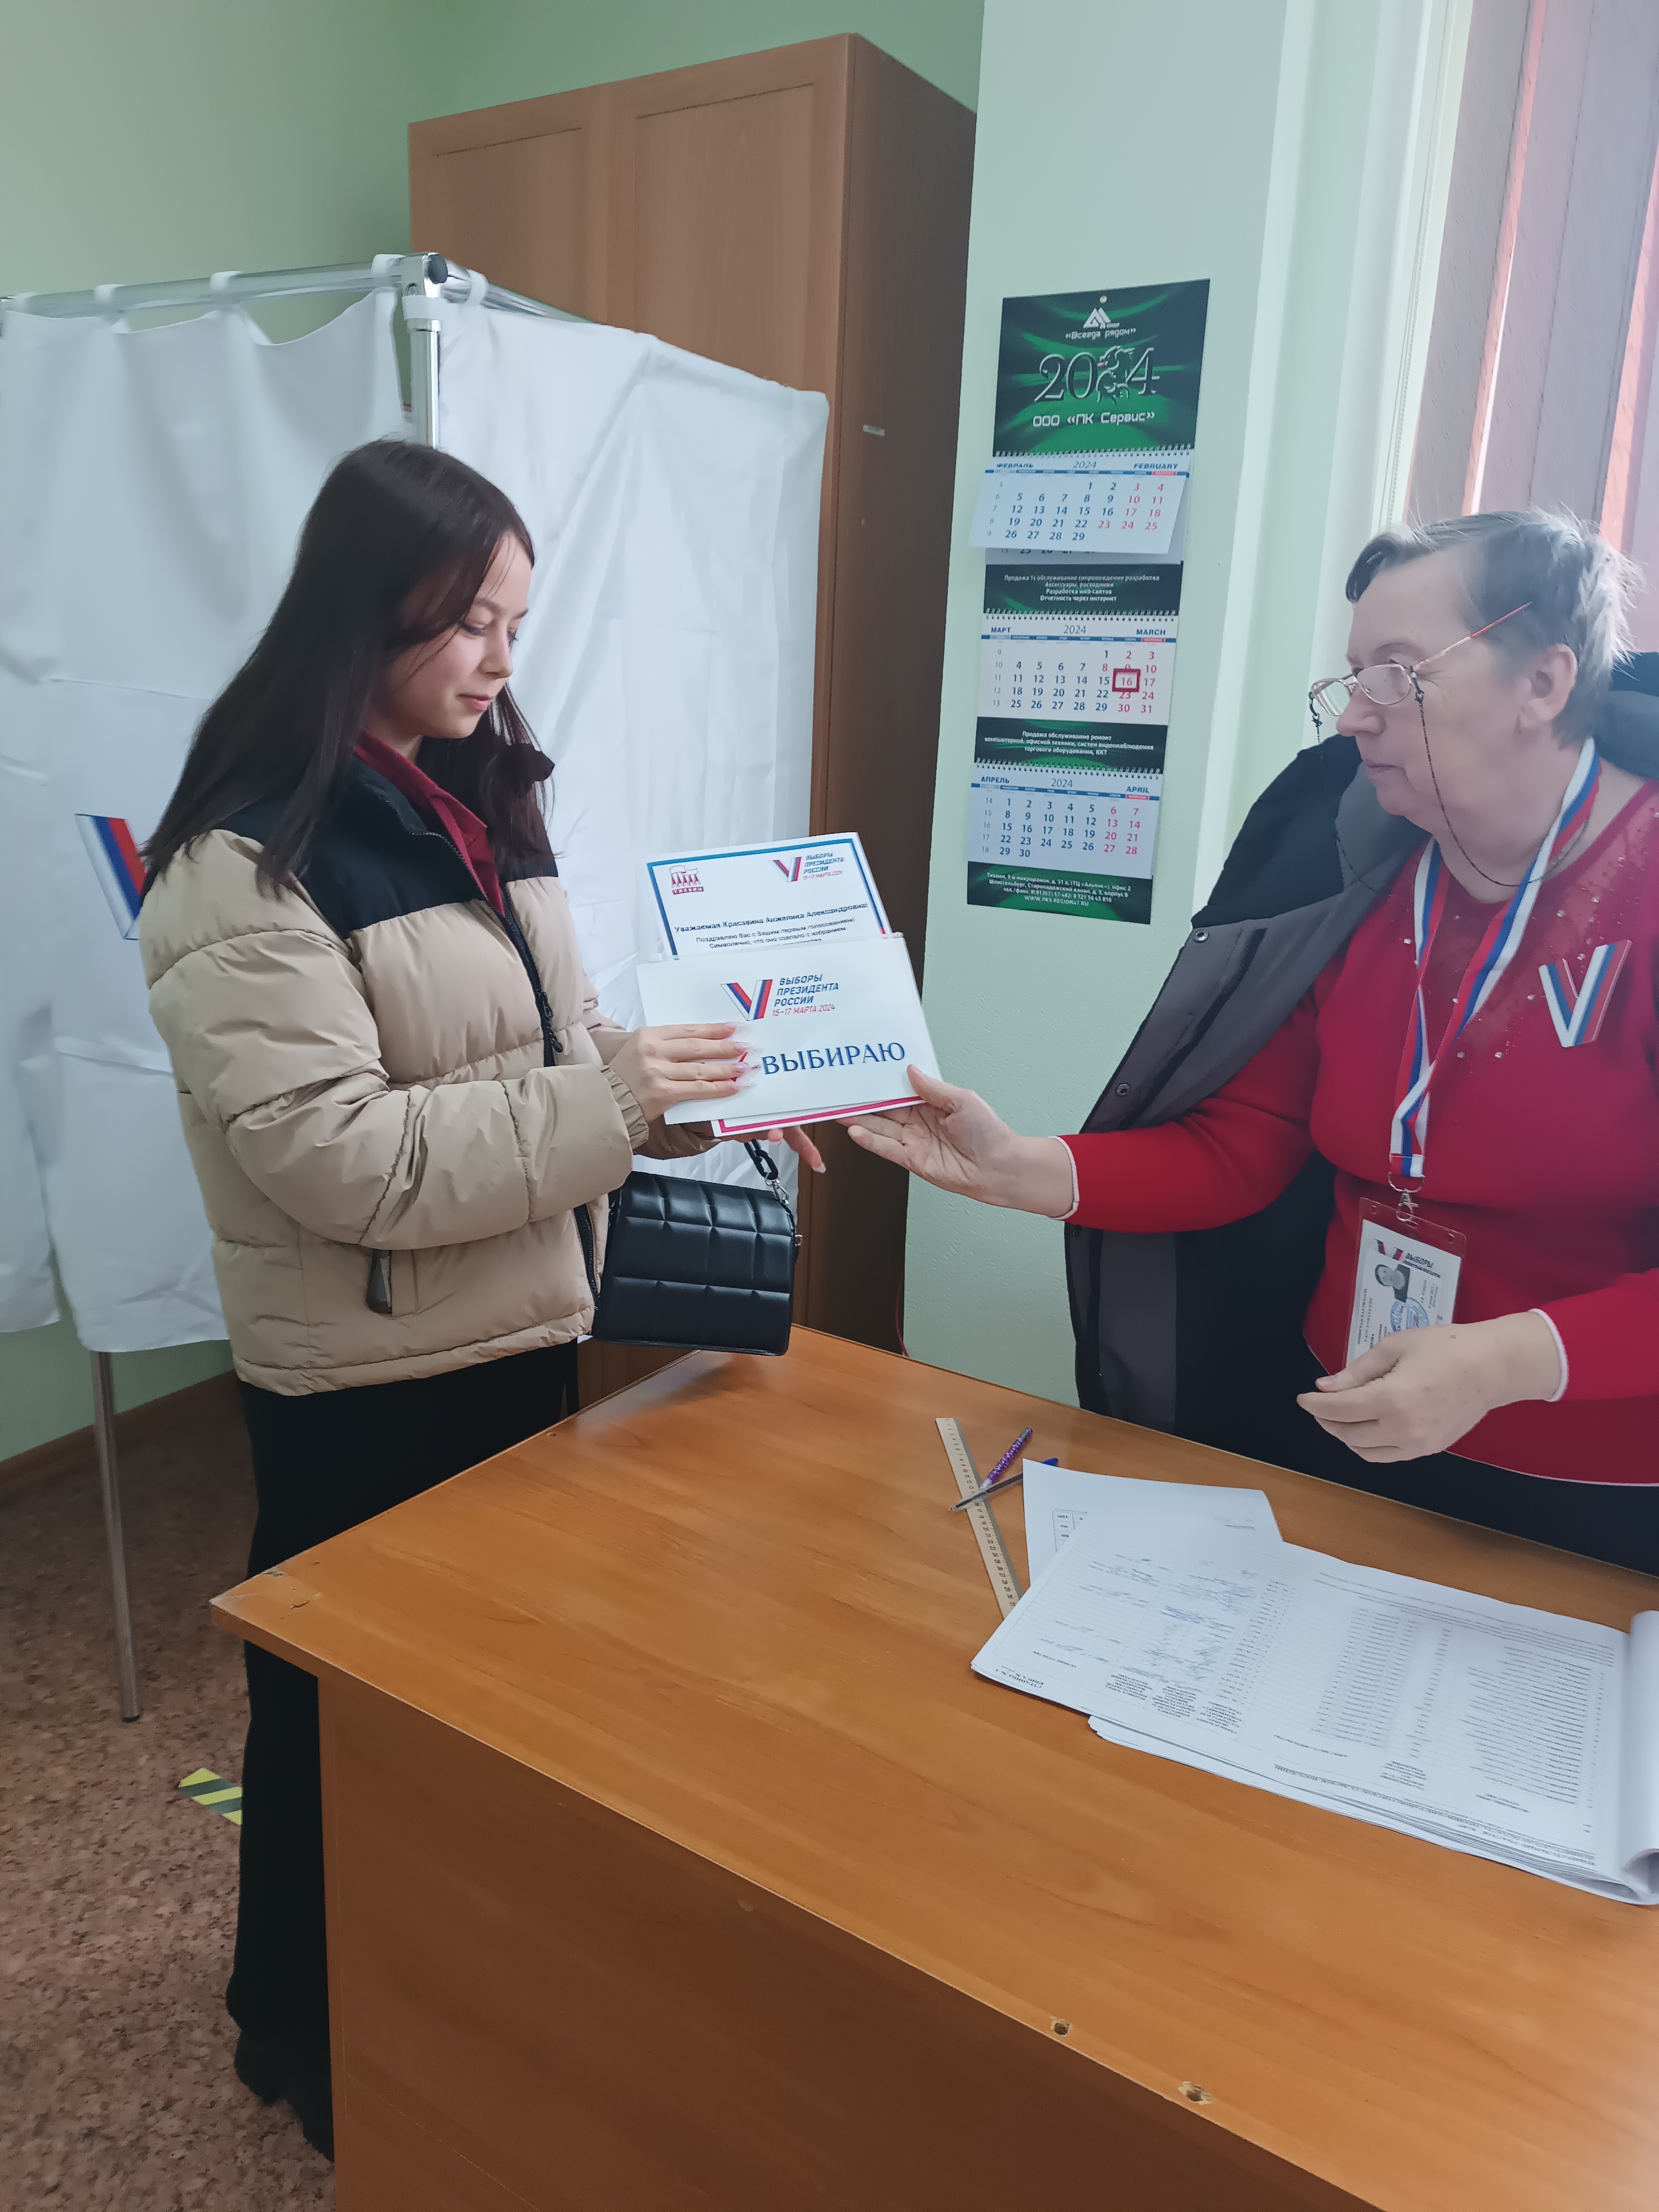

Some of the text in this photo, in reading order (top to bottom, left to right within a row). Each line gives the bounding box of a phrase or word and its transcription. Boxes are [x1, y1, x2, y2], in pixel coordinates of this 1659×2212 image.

[1032, 411, 1155, 428] ООО «ПК Сервис»
[1110, 482, 1117, 491] 2
[1039, 493, 1045, 502] 6
[1062, 494, 1067, 502] 7
[1012, 505, 1022, 513] 12
[1103, 508, 1114, 516] 16
[1030, 518, 1042, 526] 20
[1052, 519, 1063, 528] 21
[1075, 519, 1087, 528] 22
[1098, 520, 1110, 529] 23
[1121, 521, 1134, 529] 24
[1145, 521, 1157, 530] 25
[1005, 530, 1084, 540] 26 27 28 29
[1063, 625, 1086, 634] 2024
[1126, 651, 1131, 659] 2
[1102, 664, 1108, 672] 8
[1145, 665, 1156, 673] 10
[1013, 674, 1022, 682] 11
[1034, 675, 1044, 683] 12
[1077, 676, 1087, 684] 14
[1121, 677, 1132, 686] 16
[1144, 678, 1155, 686] 17
[1033, 687, 1043, 696] 19
[1074, 689, 1085, 697] 21
[1097, 690, 1108, 698] 22
[1142, 691, 1154, 700] 24
[1011, 700, 1151, 713] 25 26 27 28 29 30 31
[1048, 732, 1090, 740] обслуживание
[1051, 778, 1072, 787] 2024
[1065, 815, 1074, 823] 11
[1086, 817, 1096, 825] 12
[1063, 828, 1073, 836] 18
[1084, 830, 1095, 838] 19
[1128, 833, 1138, 842] 21
[1000, 834, 1011, 843] 22
[1020, 837, 1031, 845] 23
[1041, 838, 1051, 847] 24
[1061, 840, 1072, 849] 25
[1082, 842, 1093, 851] 26
[1125, 846, 1137, 854] 28
[806, 852, 833, 860] ВЫБОРЫ
[1000, 847, 1030, 857] 29 30
[805, 857, 844, 867] ПРЕЗИДЕНТА
[804, 866, 828, 874] РОССИИ
[674, 924, 721, 933] Уважаемая
[722, 919, 764, 928] Красавина
[811, 926, 846, 937] избранием
[696, 935, 737, 943] Поздравляю
[779, 974, 823, 985] ВЫБОРЫ
[776, 983, 839, 996] ПРЕЗИДЕНТА
[774, 995, 814, 1007] РОССИИ
[794, 1005, 817, 1014] МАРТА
[818, 1004, 835, 1012] 2024
[761, 1042, 905, 1075] ВЫБИРАЮ
[1405, 1253, 1434, 1268] ВЫБОРЫ
